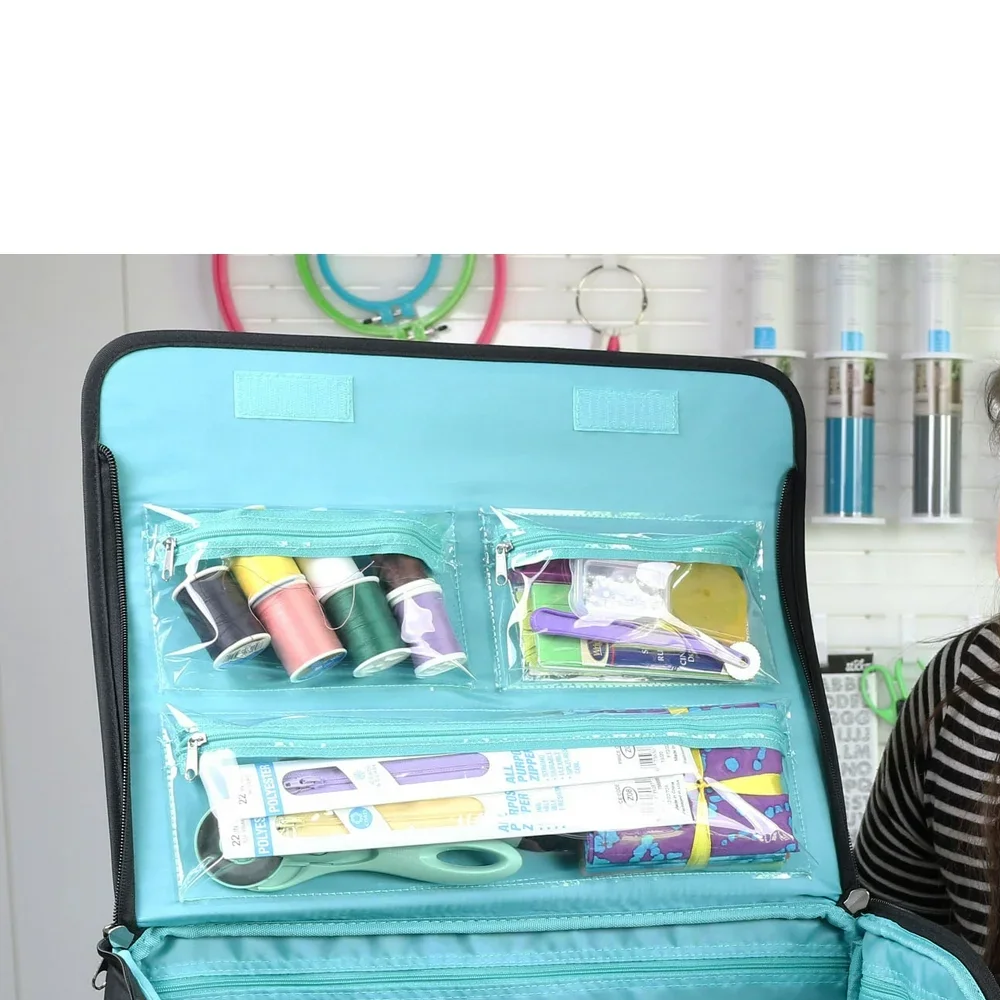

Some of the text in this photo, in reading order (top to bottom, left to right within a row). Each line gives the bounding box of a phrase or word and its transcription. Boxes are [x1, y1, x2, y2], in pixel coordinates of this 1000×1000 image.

[503, 764, 516, 784] ALL
[510, 750, 528, 782] PURPO
[524, 750, 540, 781] ZIPPE
[260, 764, 282, 814] POLYESTER
[231, 834, 241, 846] 22
[254, 816, 271, 854] POLYES
